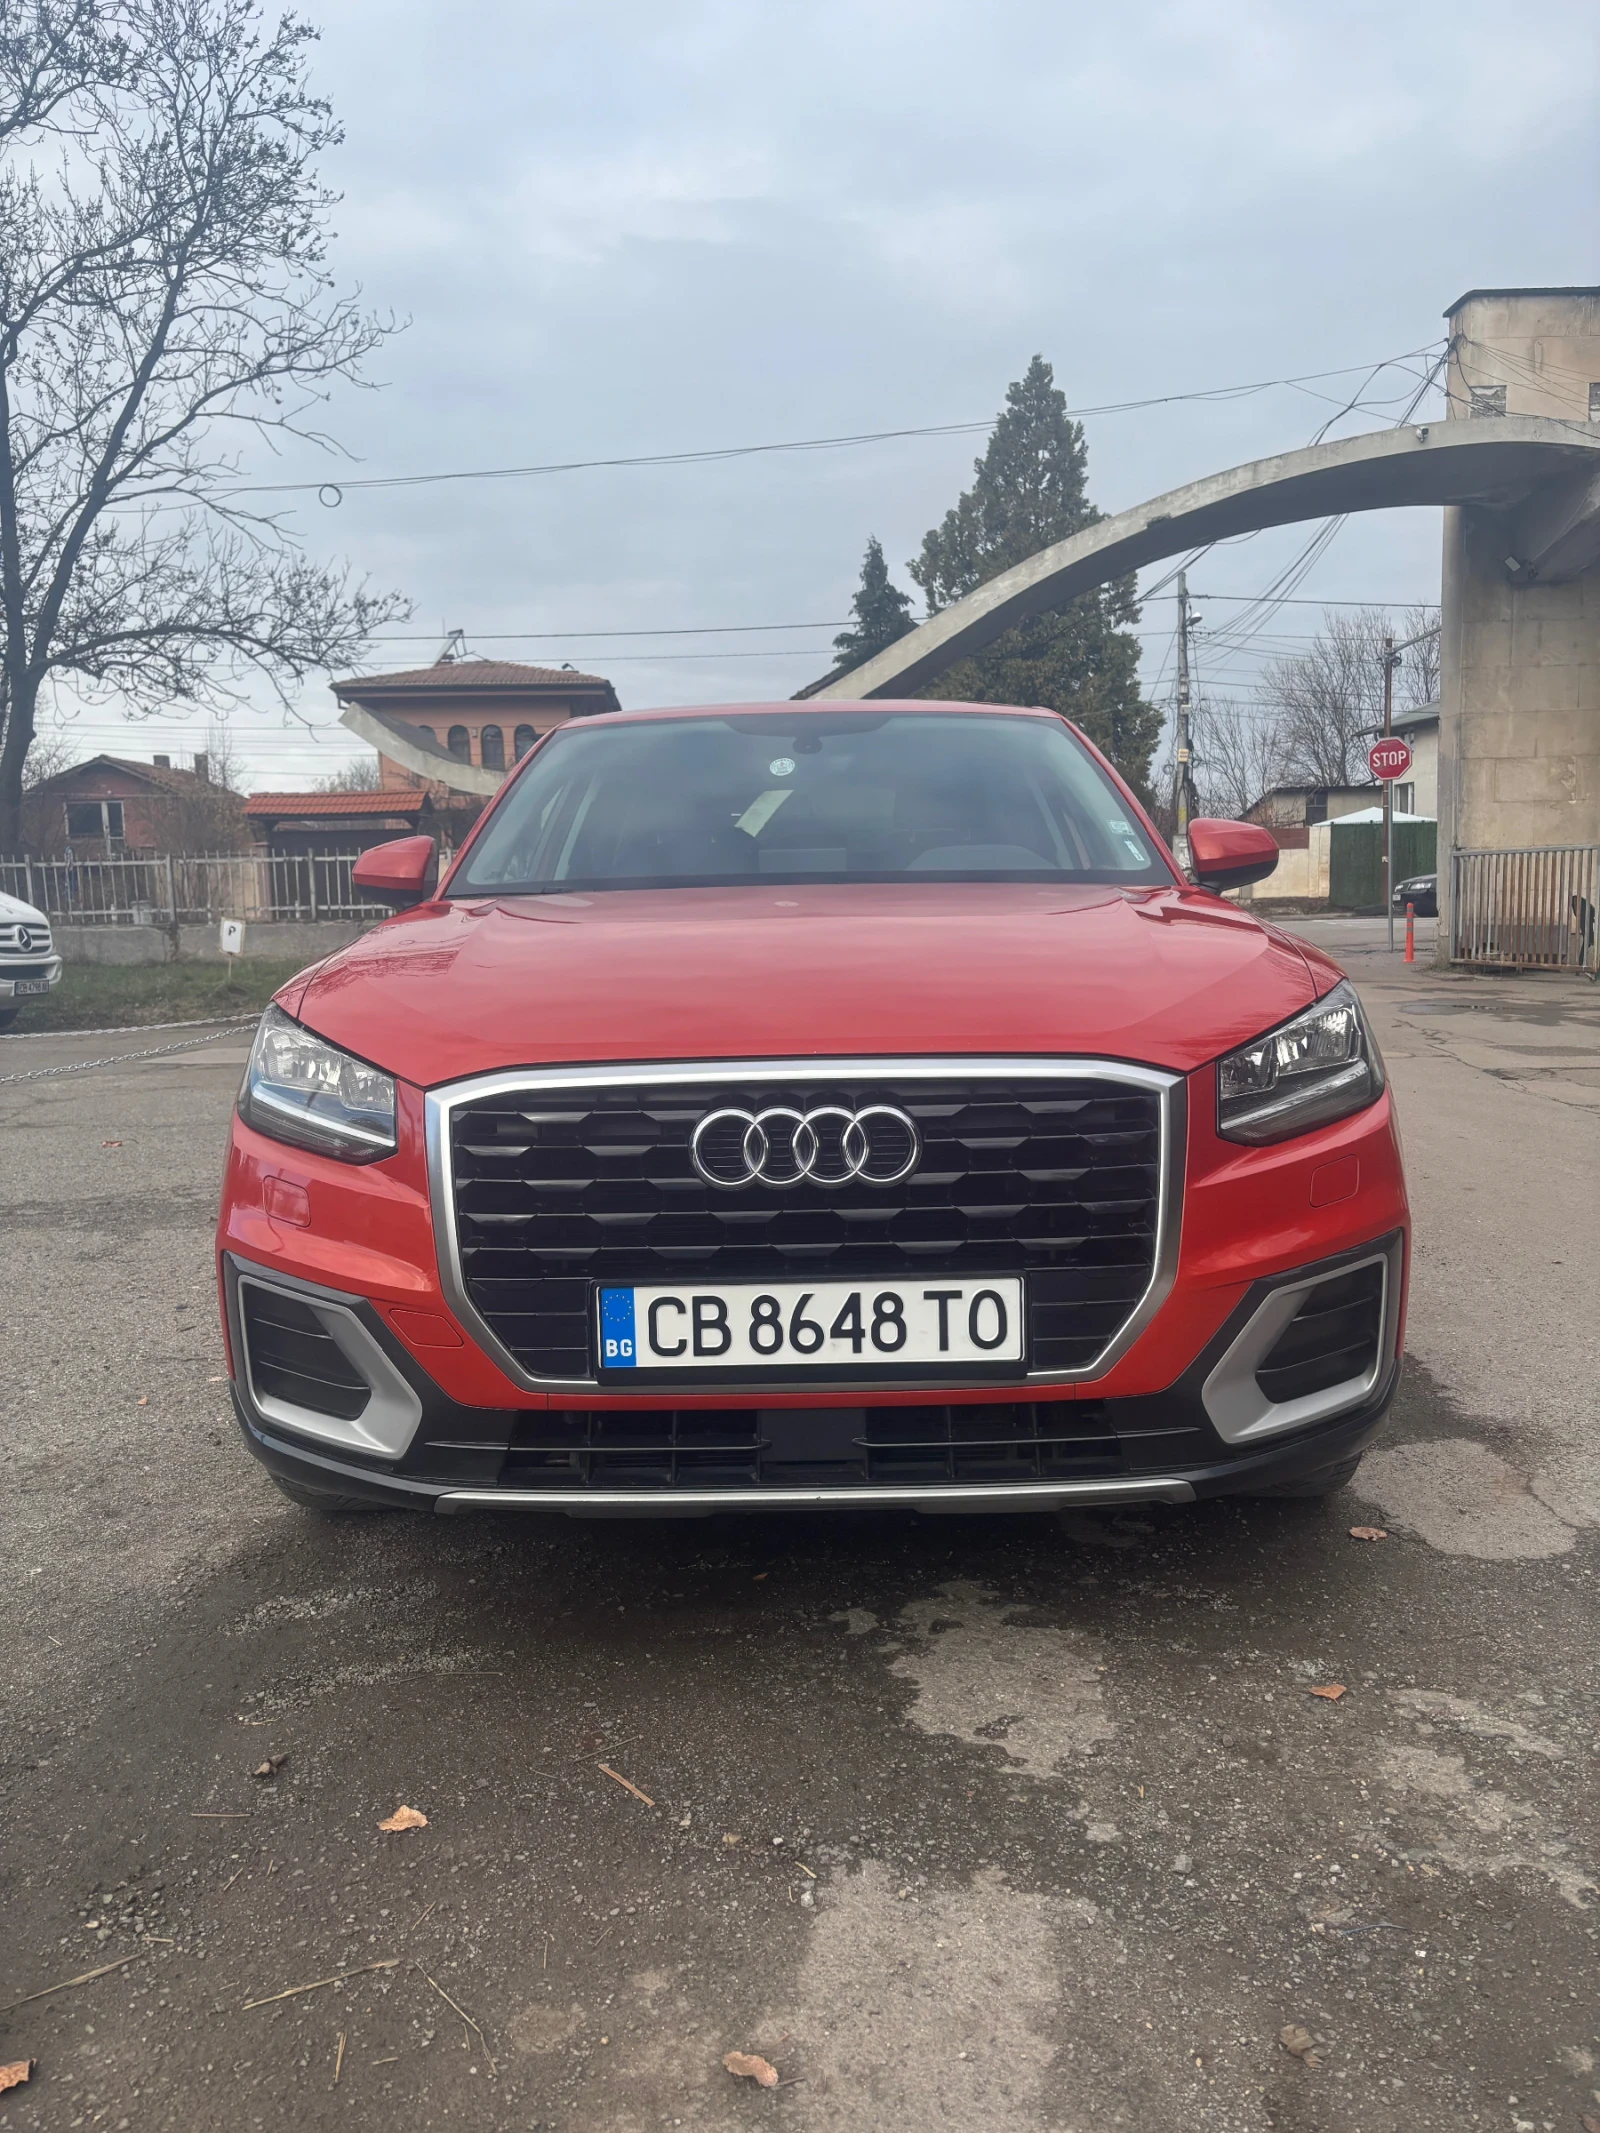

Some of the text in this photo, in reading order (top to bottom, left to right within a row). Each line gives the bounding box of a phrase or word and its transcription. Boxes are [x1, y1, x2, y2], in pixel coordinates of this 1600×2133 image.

[1372, 750, 1407, 767] STOP
[647, 1289, 1008, 1357] CB 8648 TO
[605, 1338, 633, 1357] BG
